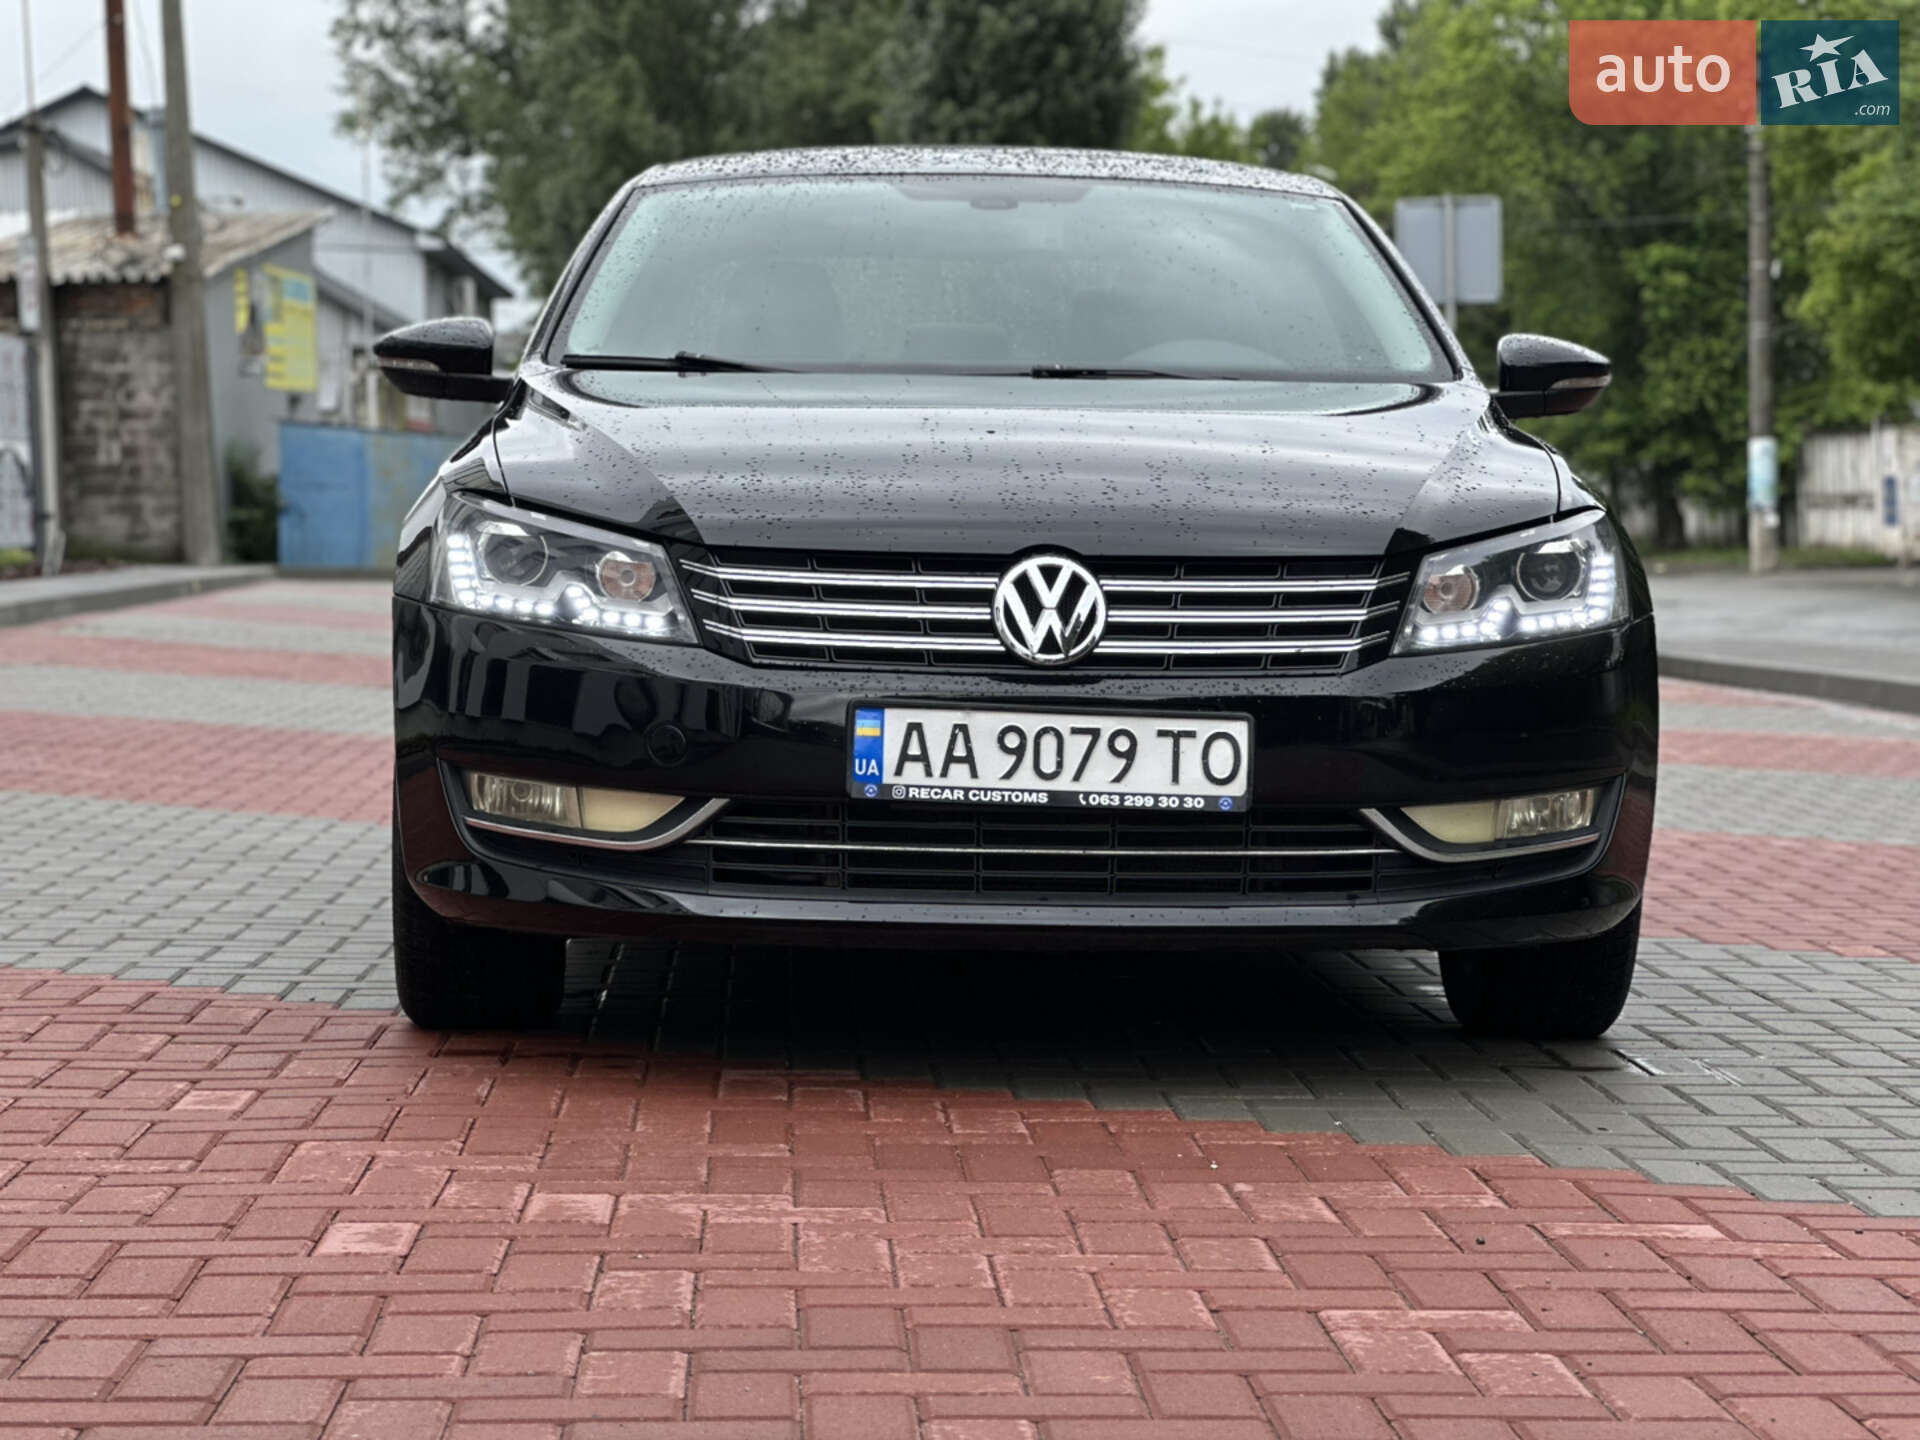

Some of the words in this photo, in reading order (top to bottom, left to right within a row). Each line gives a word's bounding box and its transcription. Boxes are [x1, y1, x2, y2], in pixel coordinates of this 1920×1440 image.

[997, 557, 1104, 662] VW
[893, 721, 979, 780] AA
[996, 724, 1138, 784] 9079
[1156, 729, 1242, 786] TO
[855, 758, 880, 776] UA
[908, 786, 965, 801] RECAR
[968, 790, 1049, 803] CUSTOMS
[1088, 794, 1120, 807] 063
[1123, 795, 1155, 808] 299
[1158, 796, 1179, 808] 30
[1183, 797, 1205, 809] 30
